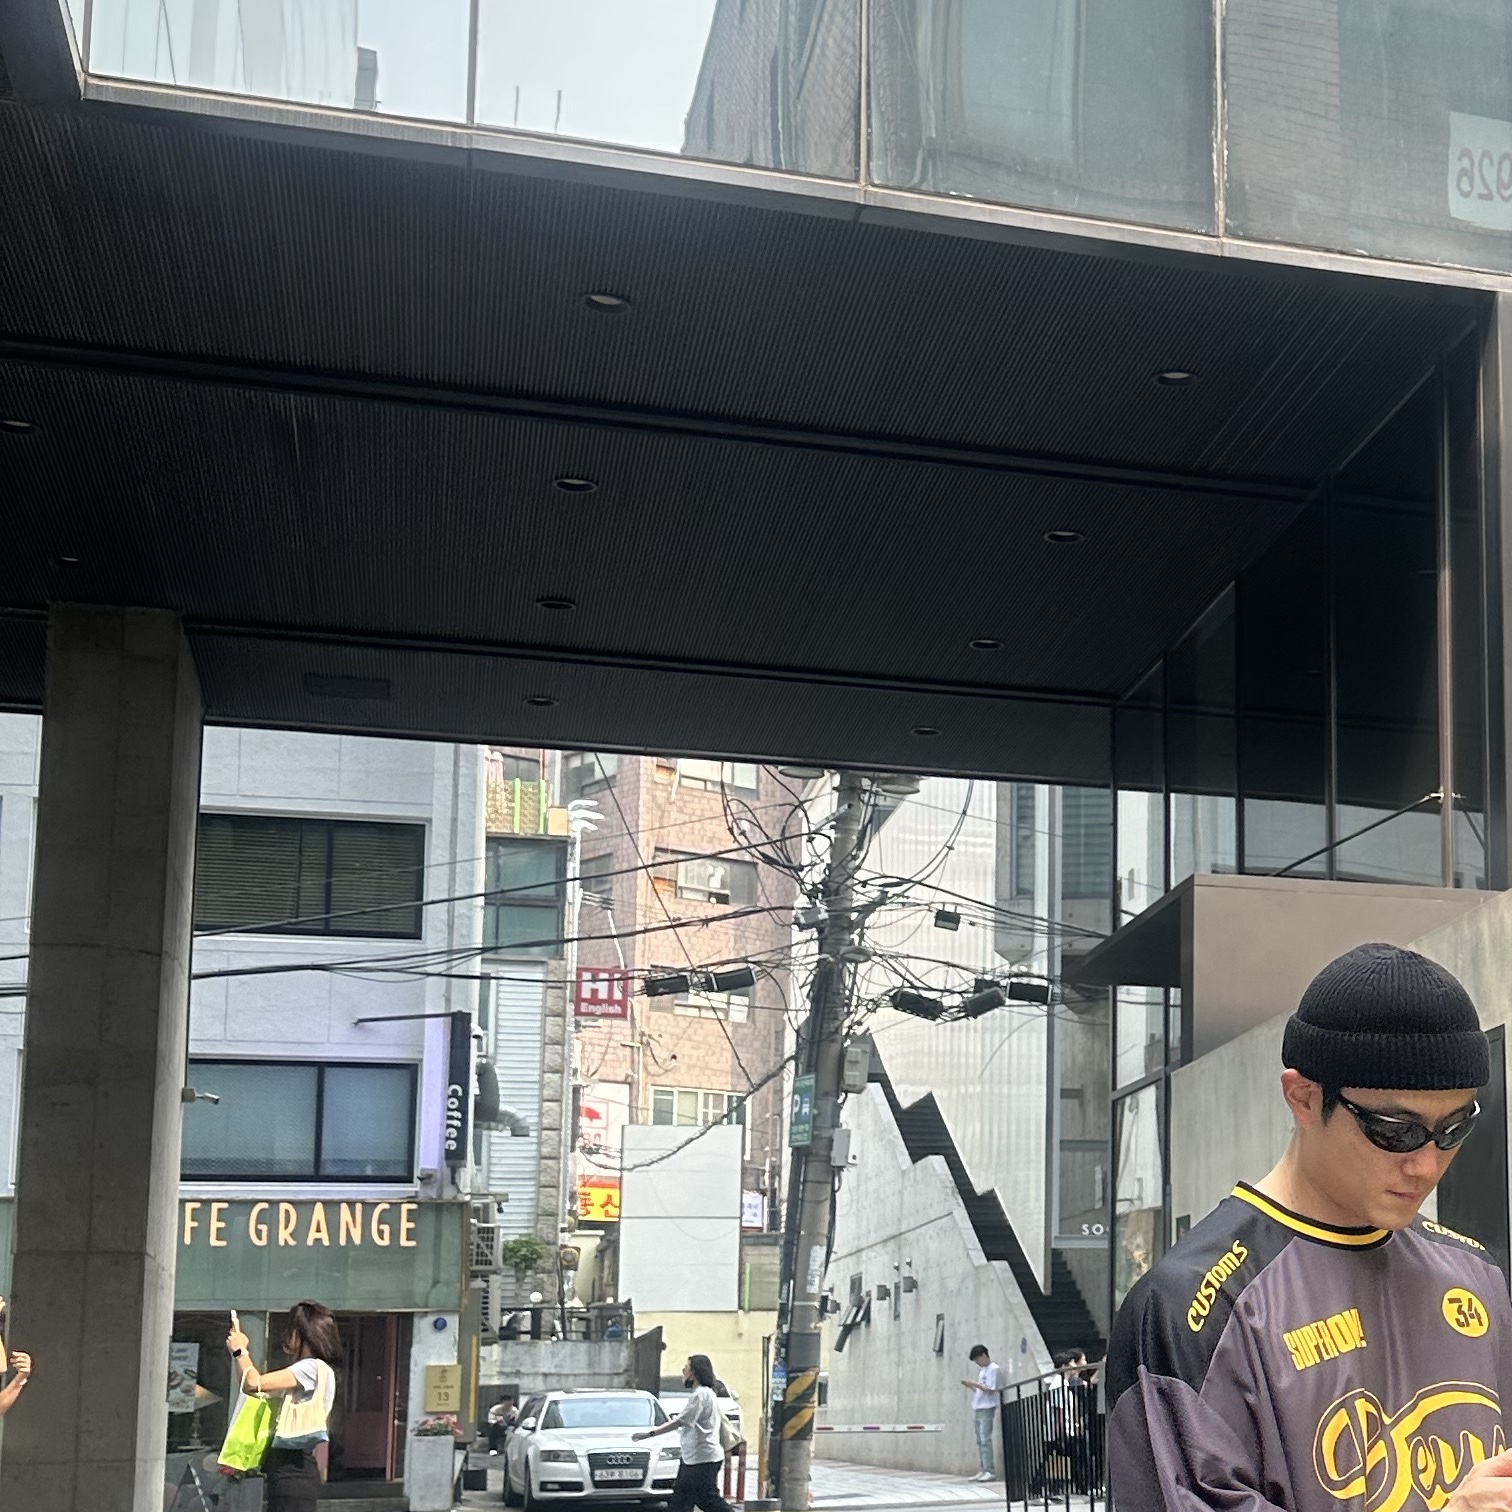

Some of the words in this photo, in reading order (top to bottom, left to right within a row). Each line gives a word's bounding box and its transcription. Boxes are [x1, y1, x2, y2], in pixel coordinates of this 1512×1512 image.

[580, 1001, 623, 1015] English
[444, 1084, 463, 1150] Coffee
[248, 1200, 418, 1247] GRANGE
[1081, 1223, 1110, 1236] SO
[1446, 1297, 1484, 1328] 34
